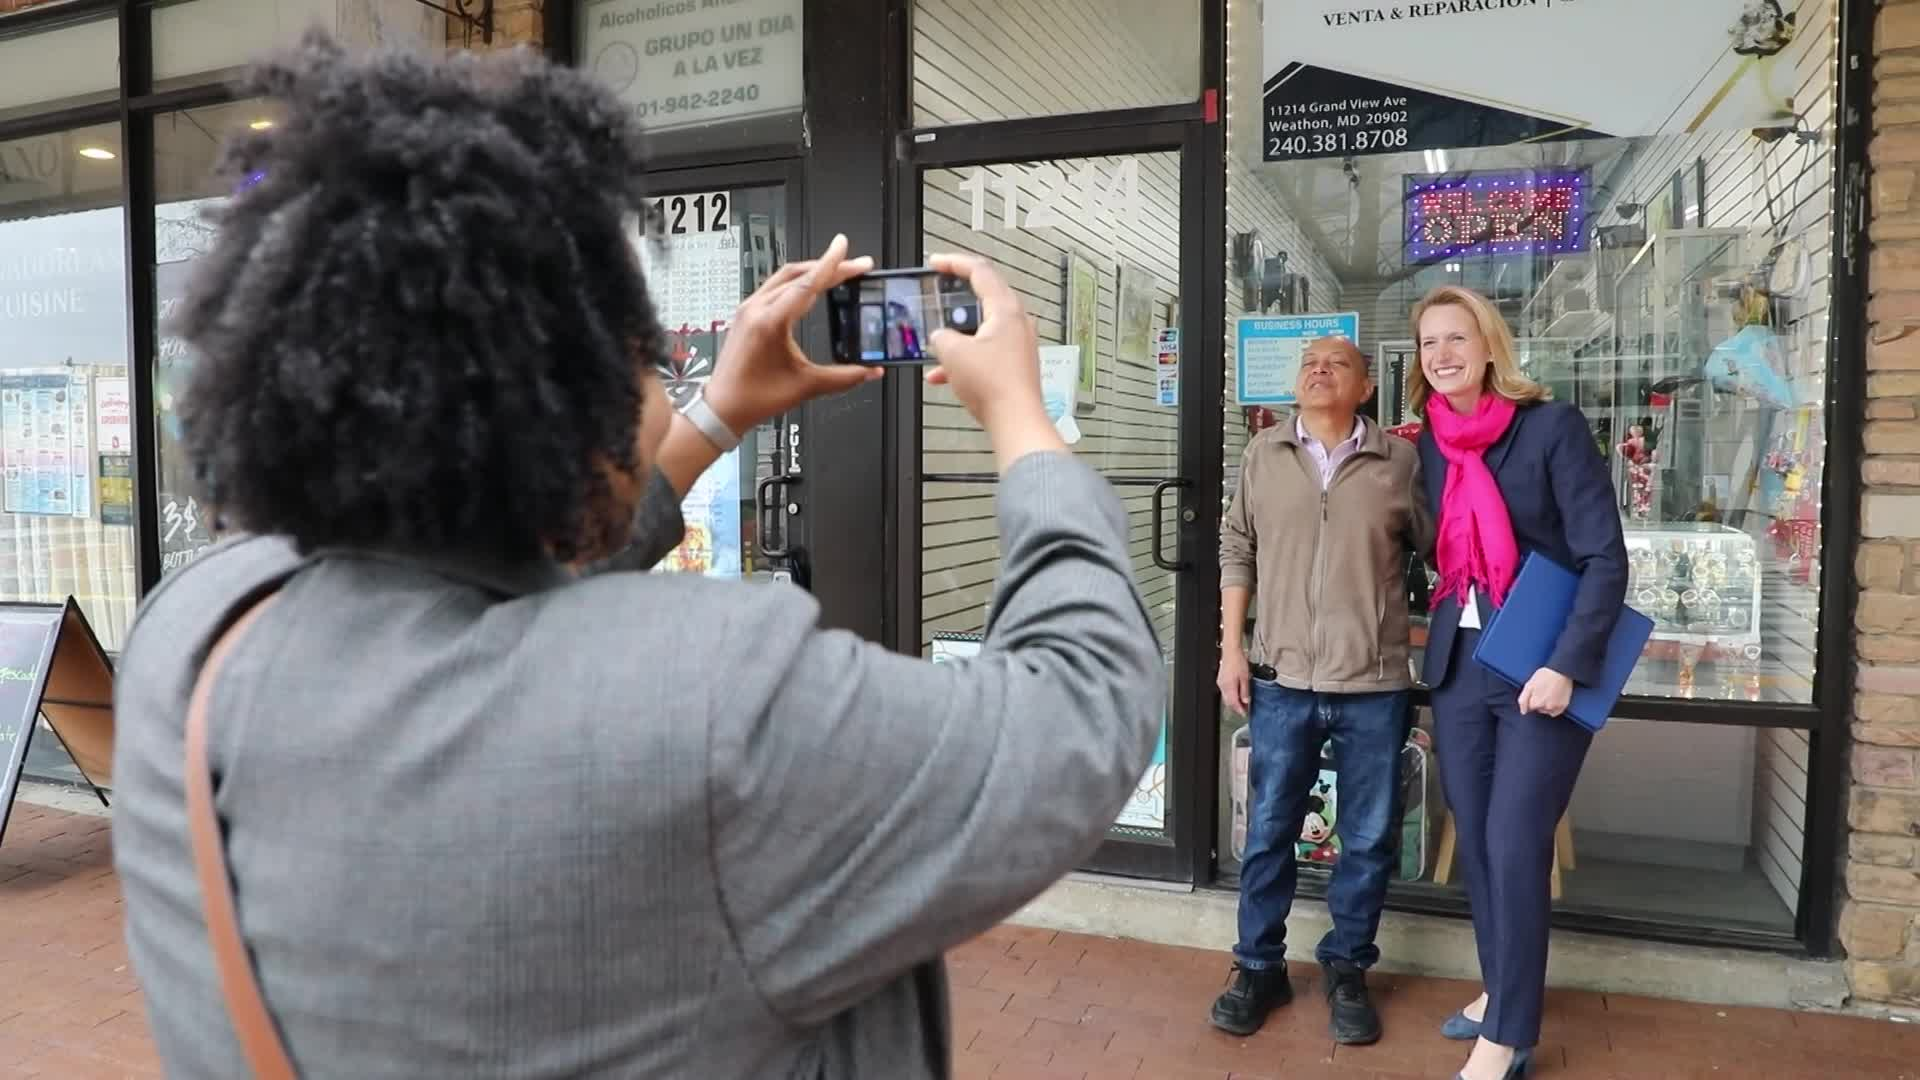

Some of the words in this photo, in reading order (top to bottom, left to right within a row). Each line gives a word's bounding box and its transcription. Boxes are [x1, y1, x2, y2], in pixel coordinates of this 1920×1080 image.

[599, 1, 697, 29] Alcoholicos
[1323, 10, 1385, 27] VENTA
[1390, 7, 1404, 20] &
[645, 29, 715, 56] GRUPO
[721, 21, 752, 43] UN
[759, 15, 794, 37] DIA
[673, 60, 688, 78] A
[692, 55, 718, 75] LA
[723, 48, 763, 70] VEZ
[638, 84, 760, 118] 01-942-2240
[1271, 103, 1306, 116] 11214
[1309, 100, 1347, 114] Grand
[1349, 99, 1380, 110] View
[1383, 96, 1407, 107] Ave
[1269, 118, 1333, 132] Weathon,
[1337, 114, 1360, 127] MD
[1366, 111, 1407, 125] 20902
[1269, 128, 1408, 156] 240.381.8708
[959, 159, 1144, 232] 11214
[1421, 187, 1573, 214] WELCOME
[1423, 211, 1570, 246] OPEN
[0, 288, 87, 319] UISINE
[1254, 320, 1302, 330] BUSINESS
[1304, 318, 1340, 329] HOURS
[788, 423, 802, 473] PULL
